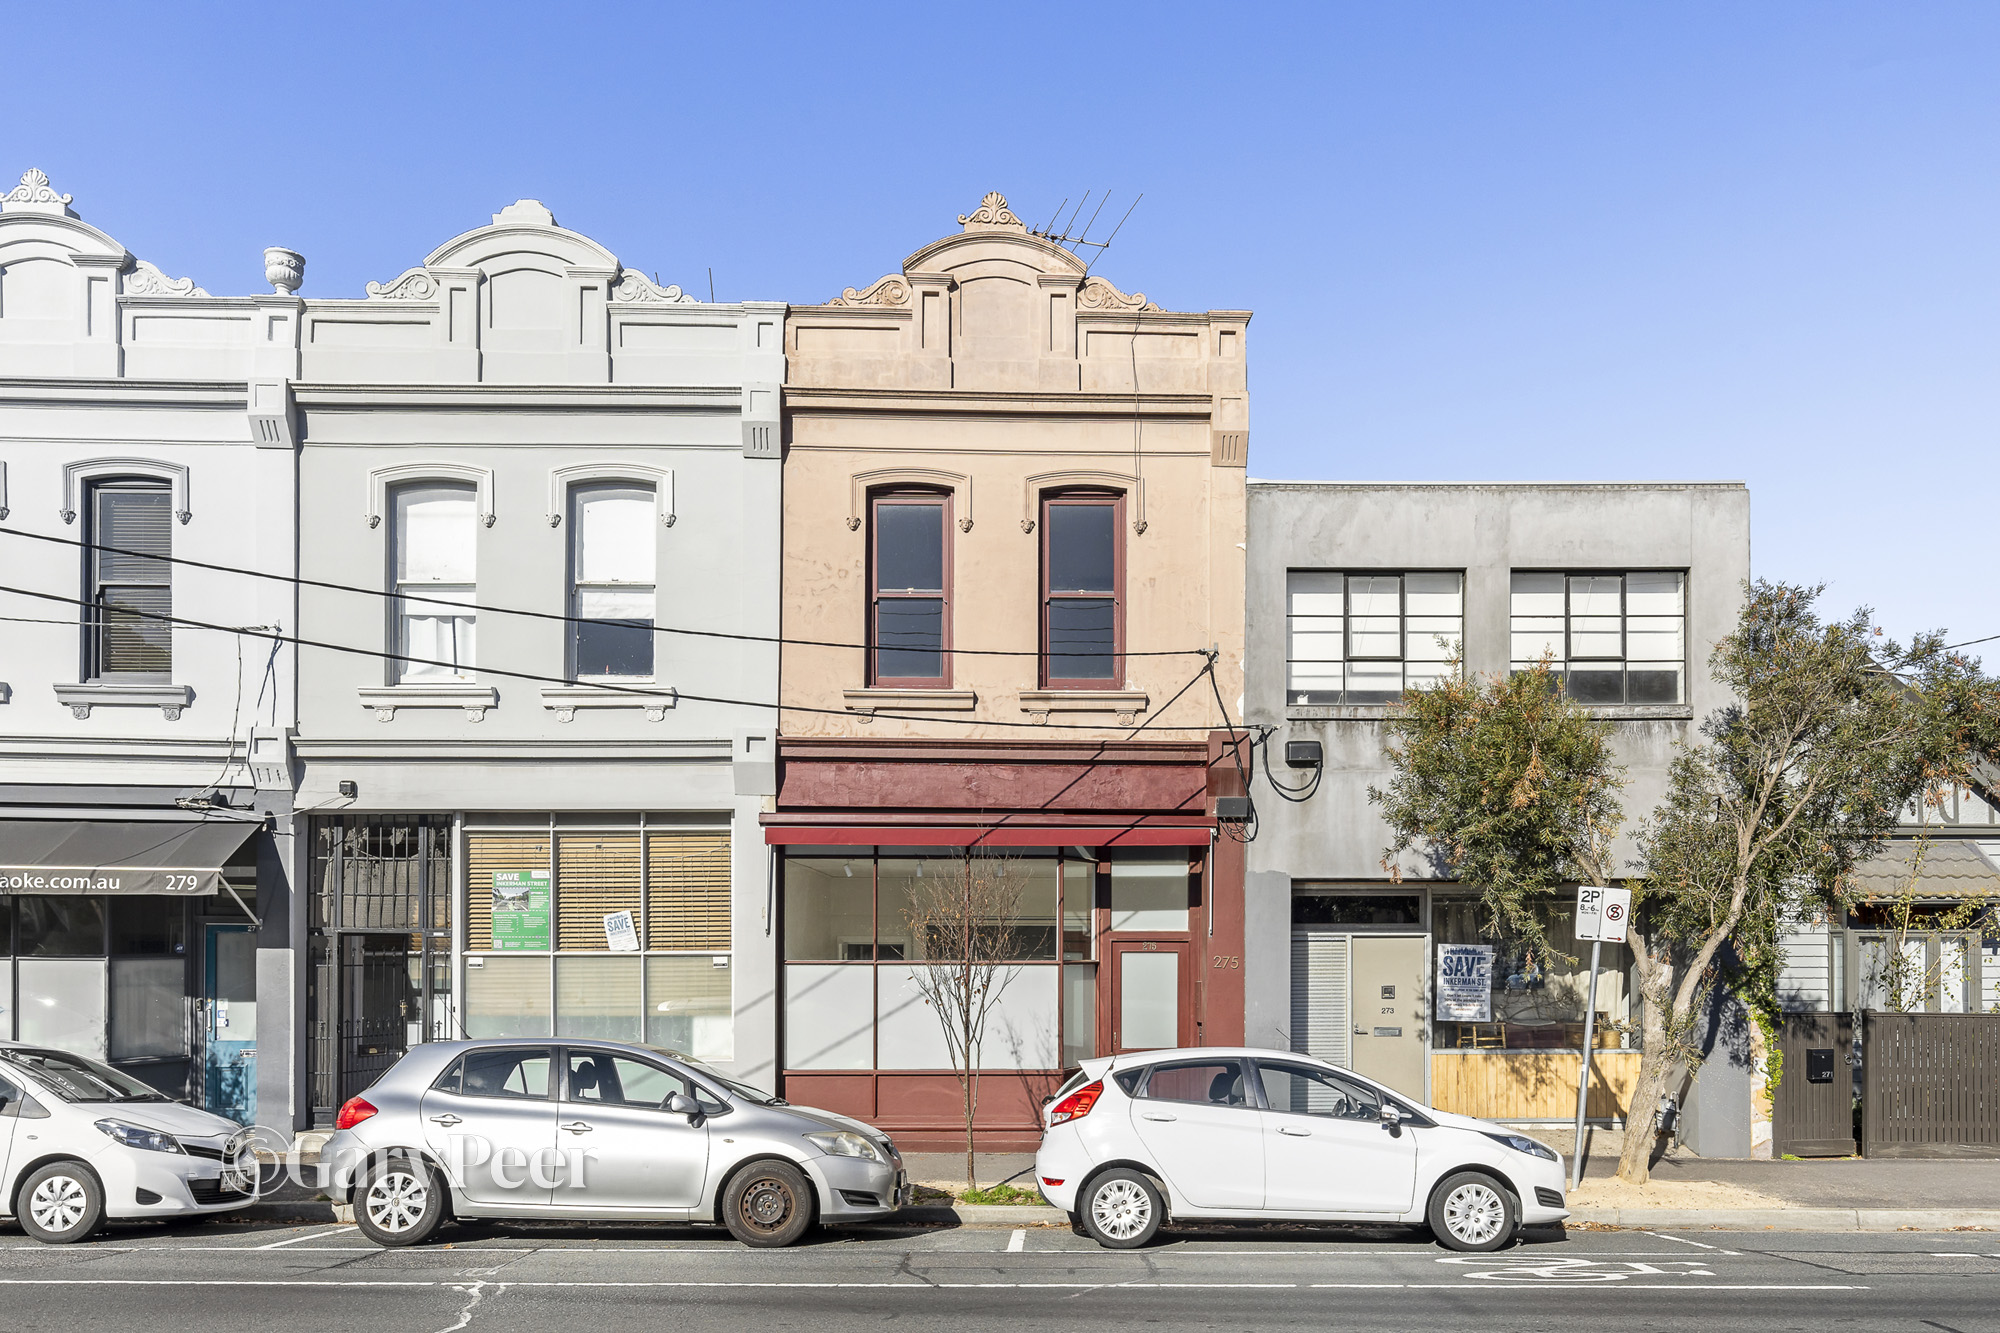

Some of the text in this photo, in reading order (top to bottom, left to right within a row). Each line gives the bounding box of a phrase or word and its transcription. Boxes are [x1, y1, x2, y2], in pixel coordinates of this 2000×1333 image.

[165, 875, 198, 890] 279
[496, 873, 520, 881] SAVE
[1581, 890, 1600, 903] 2P
[607, 917, 630, 932] SAVE
[1143, 942, 1157, 950] 275
[1213, 956, 1239, 969] 275
[1443, 956, 1486, 977] SAVE
[1443, 977, 1476, 986] INKERMAN
